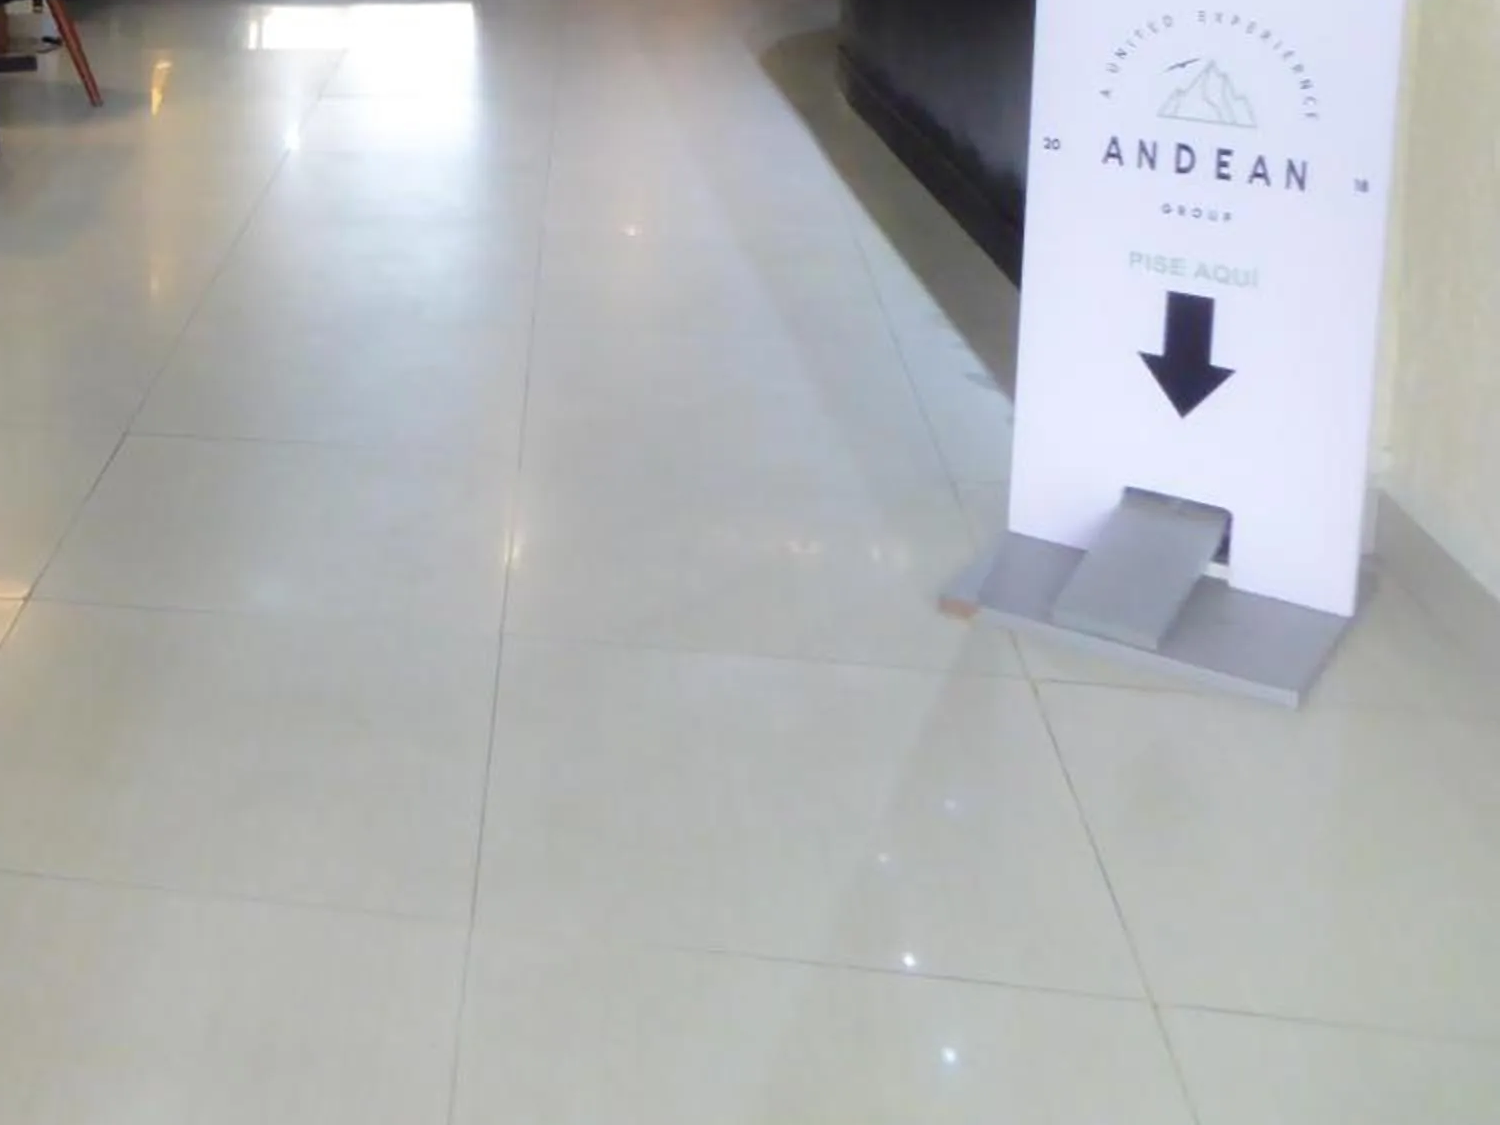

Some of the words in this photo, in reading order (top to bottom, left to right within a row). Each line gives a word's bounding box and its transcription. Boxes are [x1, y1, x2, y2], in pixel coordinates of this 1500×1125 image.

[1042, 136, 1062, 151] 20
[1101, 135, 1308, 192] ANDEAN
[1128, 250, 1188, 277] PISE
